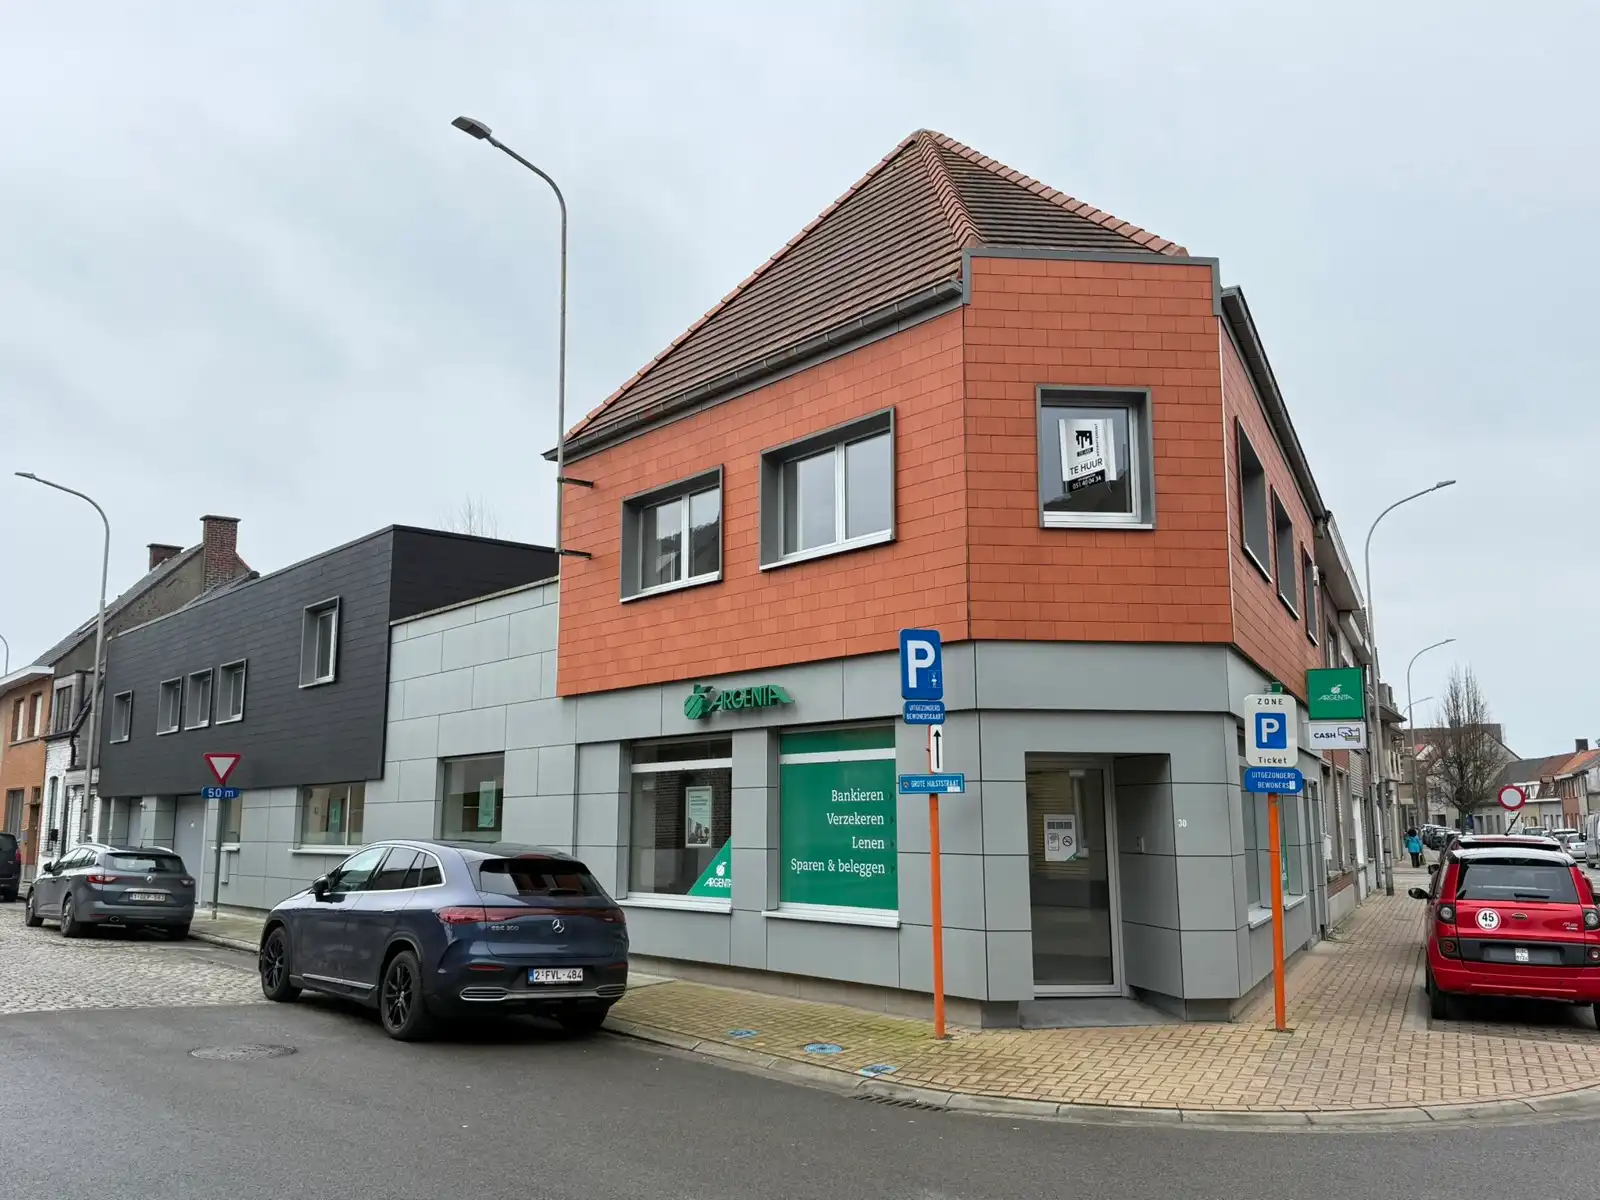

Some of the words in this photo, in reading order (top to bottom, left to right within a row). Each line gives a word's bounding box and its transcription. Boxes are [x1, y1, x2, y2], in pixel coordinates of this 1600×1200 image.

[1070, 465, 1079, 475] TE
[1080, 458, 1102, 472] HUUR
[907, 640, 935, 688] P
[708, 684, 795, 712] ARGENTA
[1261, 718, 1280, 743] P
[1258, 756, 1287, 764] Ticket
[1251, 771, 1296, 779] UITGEZONDERD
[911, 780, 926, 788] GROTE
[208, 788, 222, 798] 50
[224, 790, 234, 798] m
[831, 788, 884, 802] Bankieren
[826, 811, 885, 825] Verzekeren
[1177, 818, 1187, 828] 30
[852, 836, 885, 849] Lenen
[790, 858, 825, 874] Sparen
[827, 859, 835, 872] &
[838, 858, 885, 877] beleggen
[1482, 913, 1495, 922] 45
